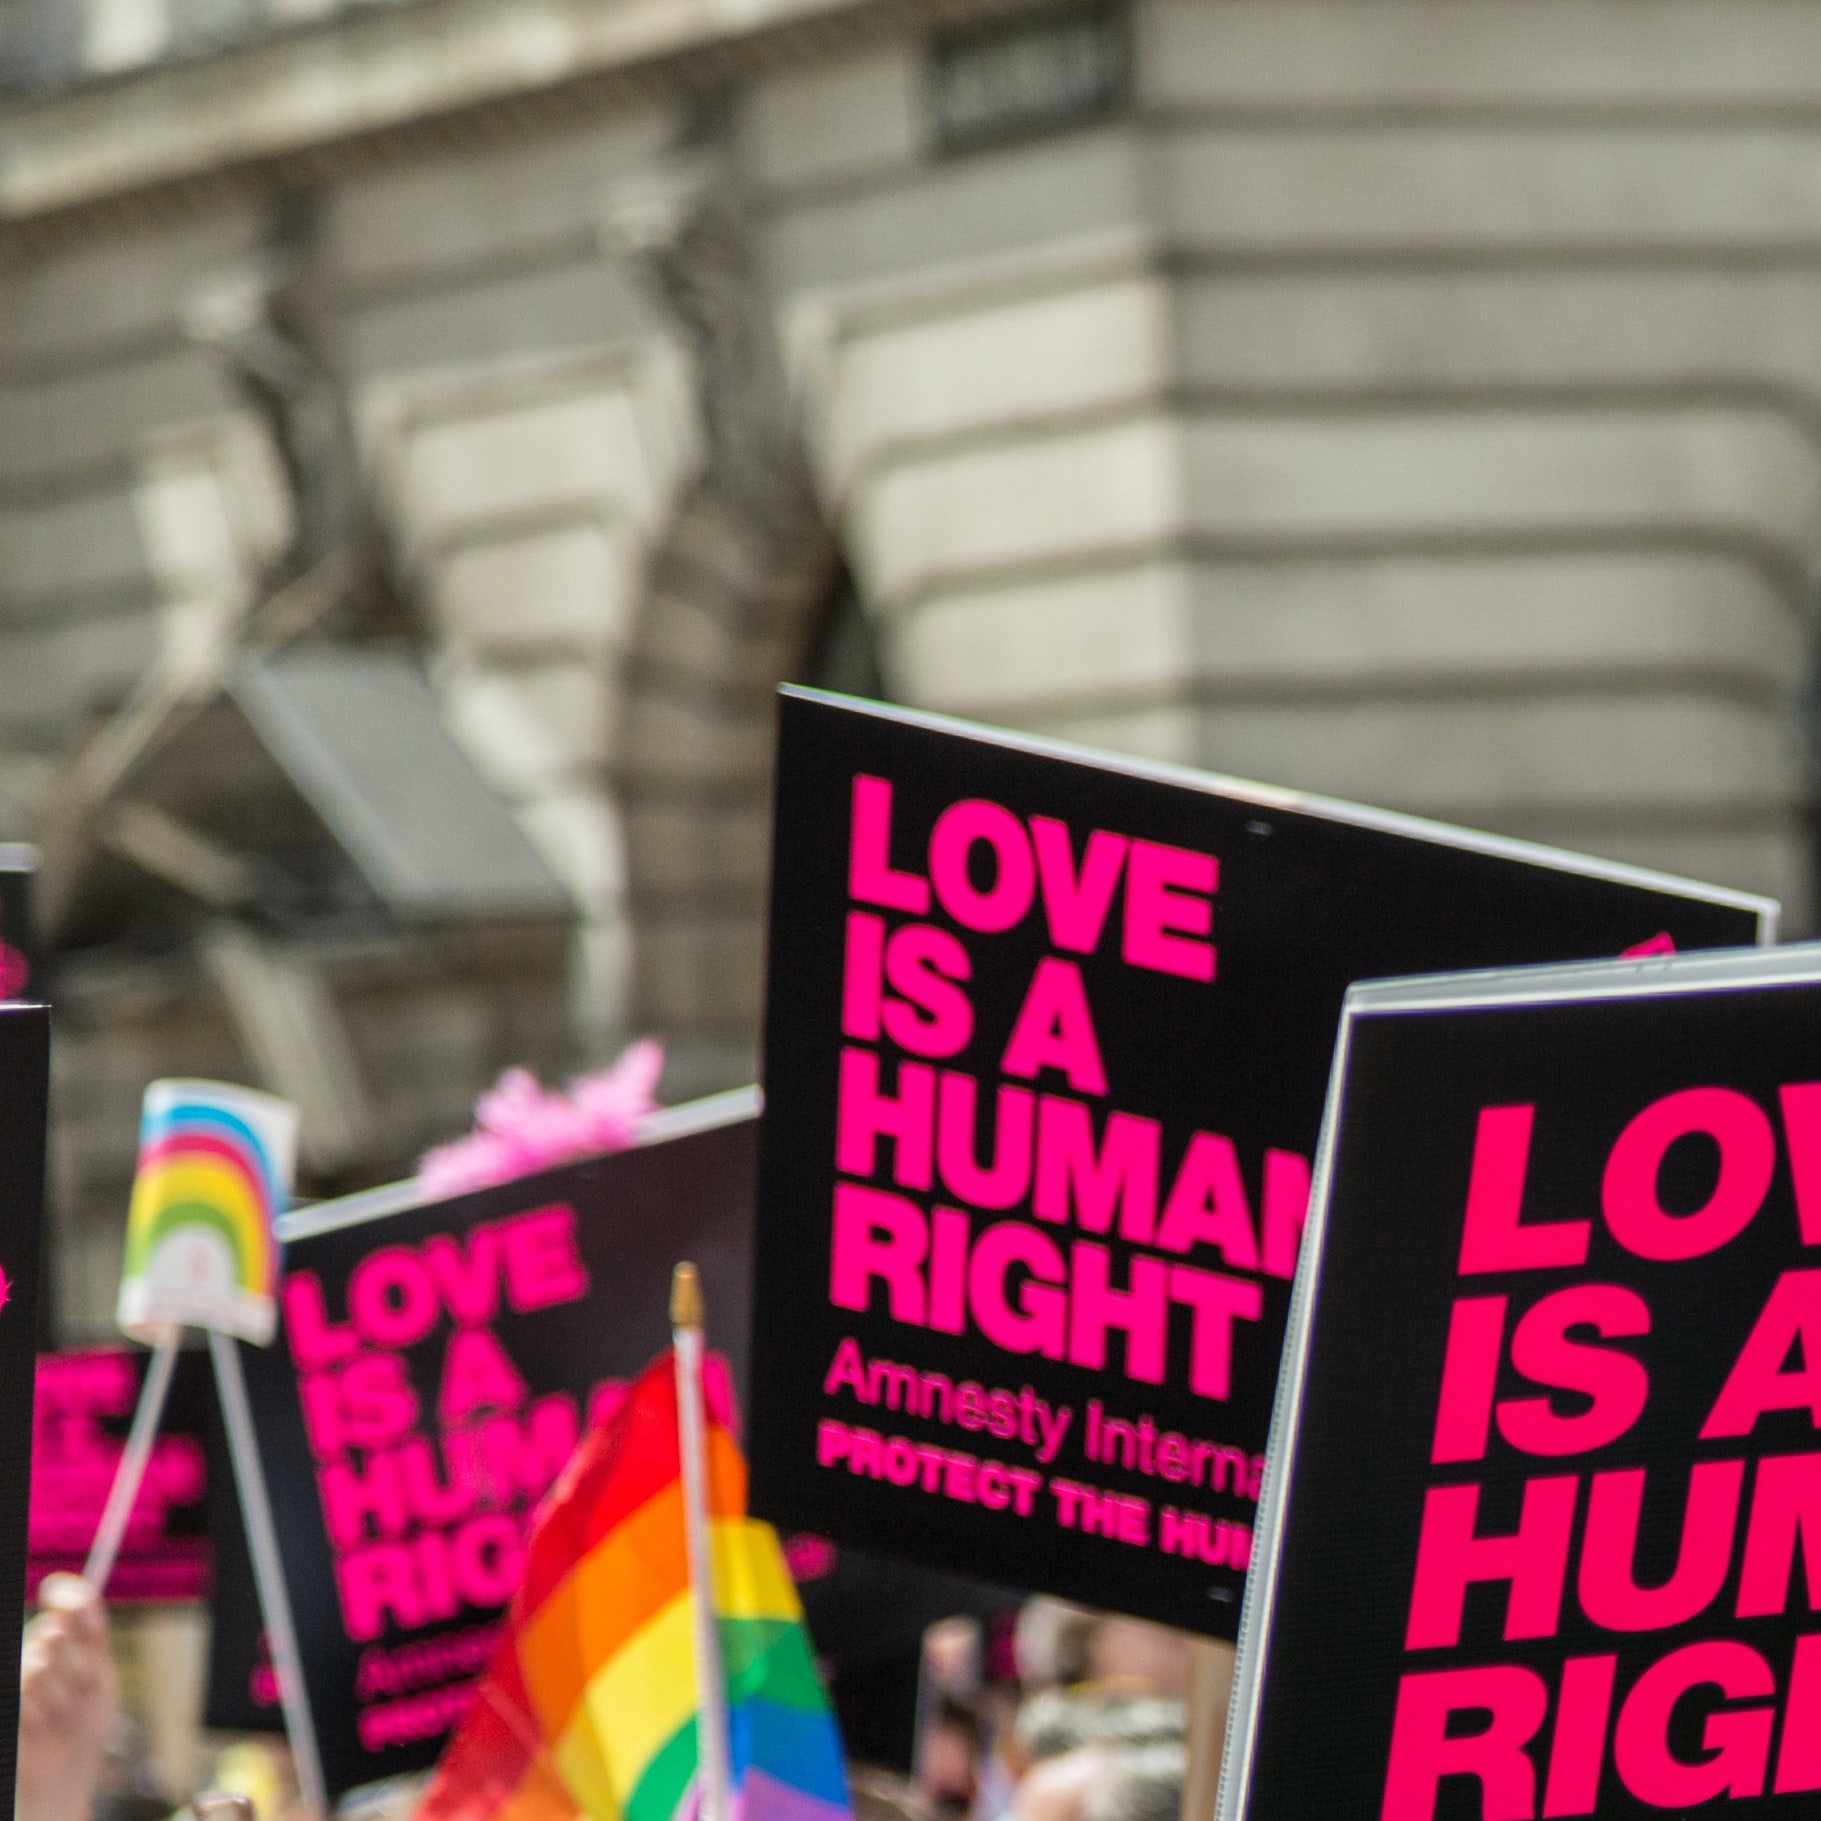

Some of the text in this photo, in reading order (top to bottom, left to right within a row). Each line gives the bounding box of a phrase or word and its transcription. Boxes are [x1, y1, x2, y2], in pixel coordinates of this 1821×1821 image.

[849, 773, 1219, 982] LOVE
[843, 911, 1109, 1096] IS A
[283, 1205, 587, 1372] LOVE
[829, 1182, 1264, 1401] RIGHT
[301, 1328, 527, 1462] IS A
[823, 1337, 1074, 1464] Amnesty
[1431, 1283, 1652, 1465] IS
[816, 1419, 1043, 1518] PROTECT
[1050, 1477, 1150, 1547] THE
[337, 1509, 529, 1643] RIG
